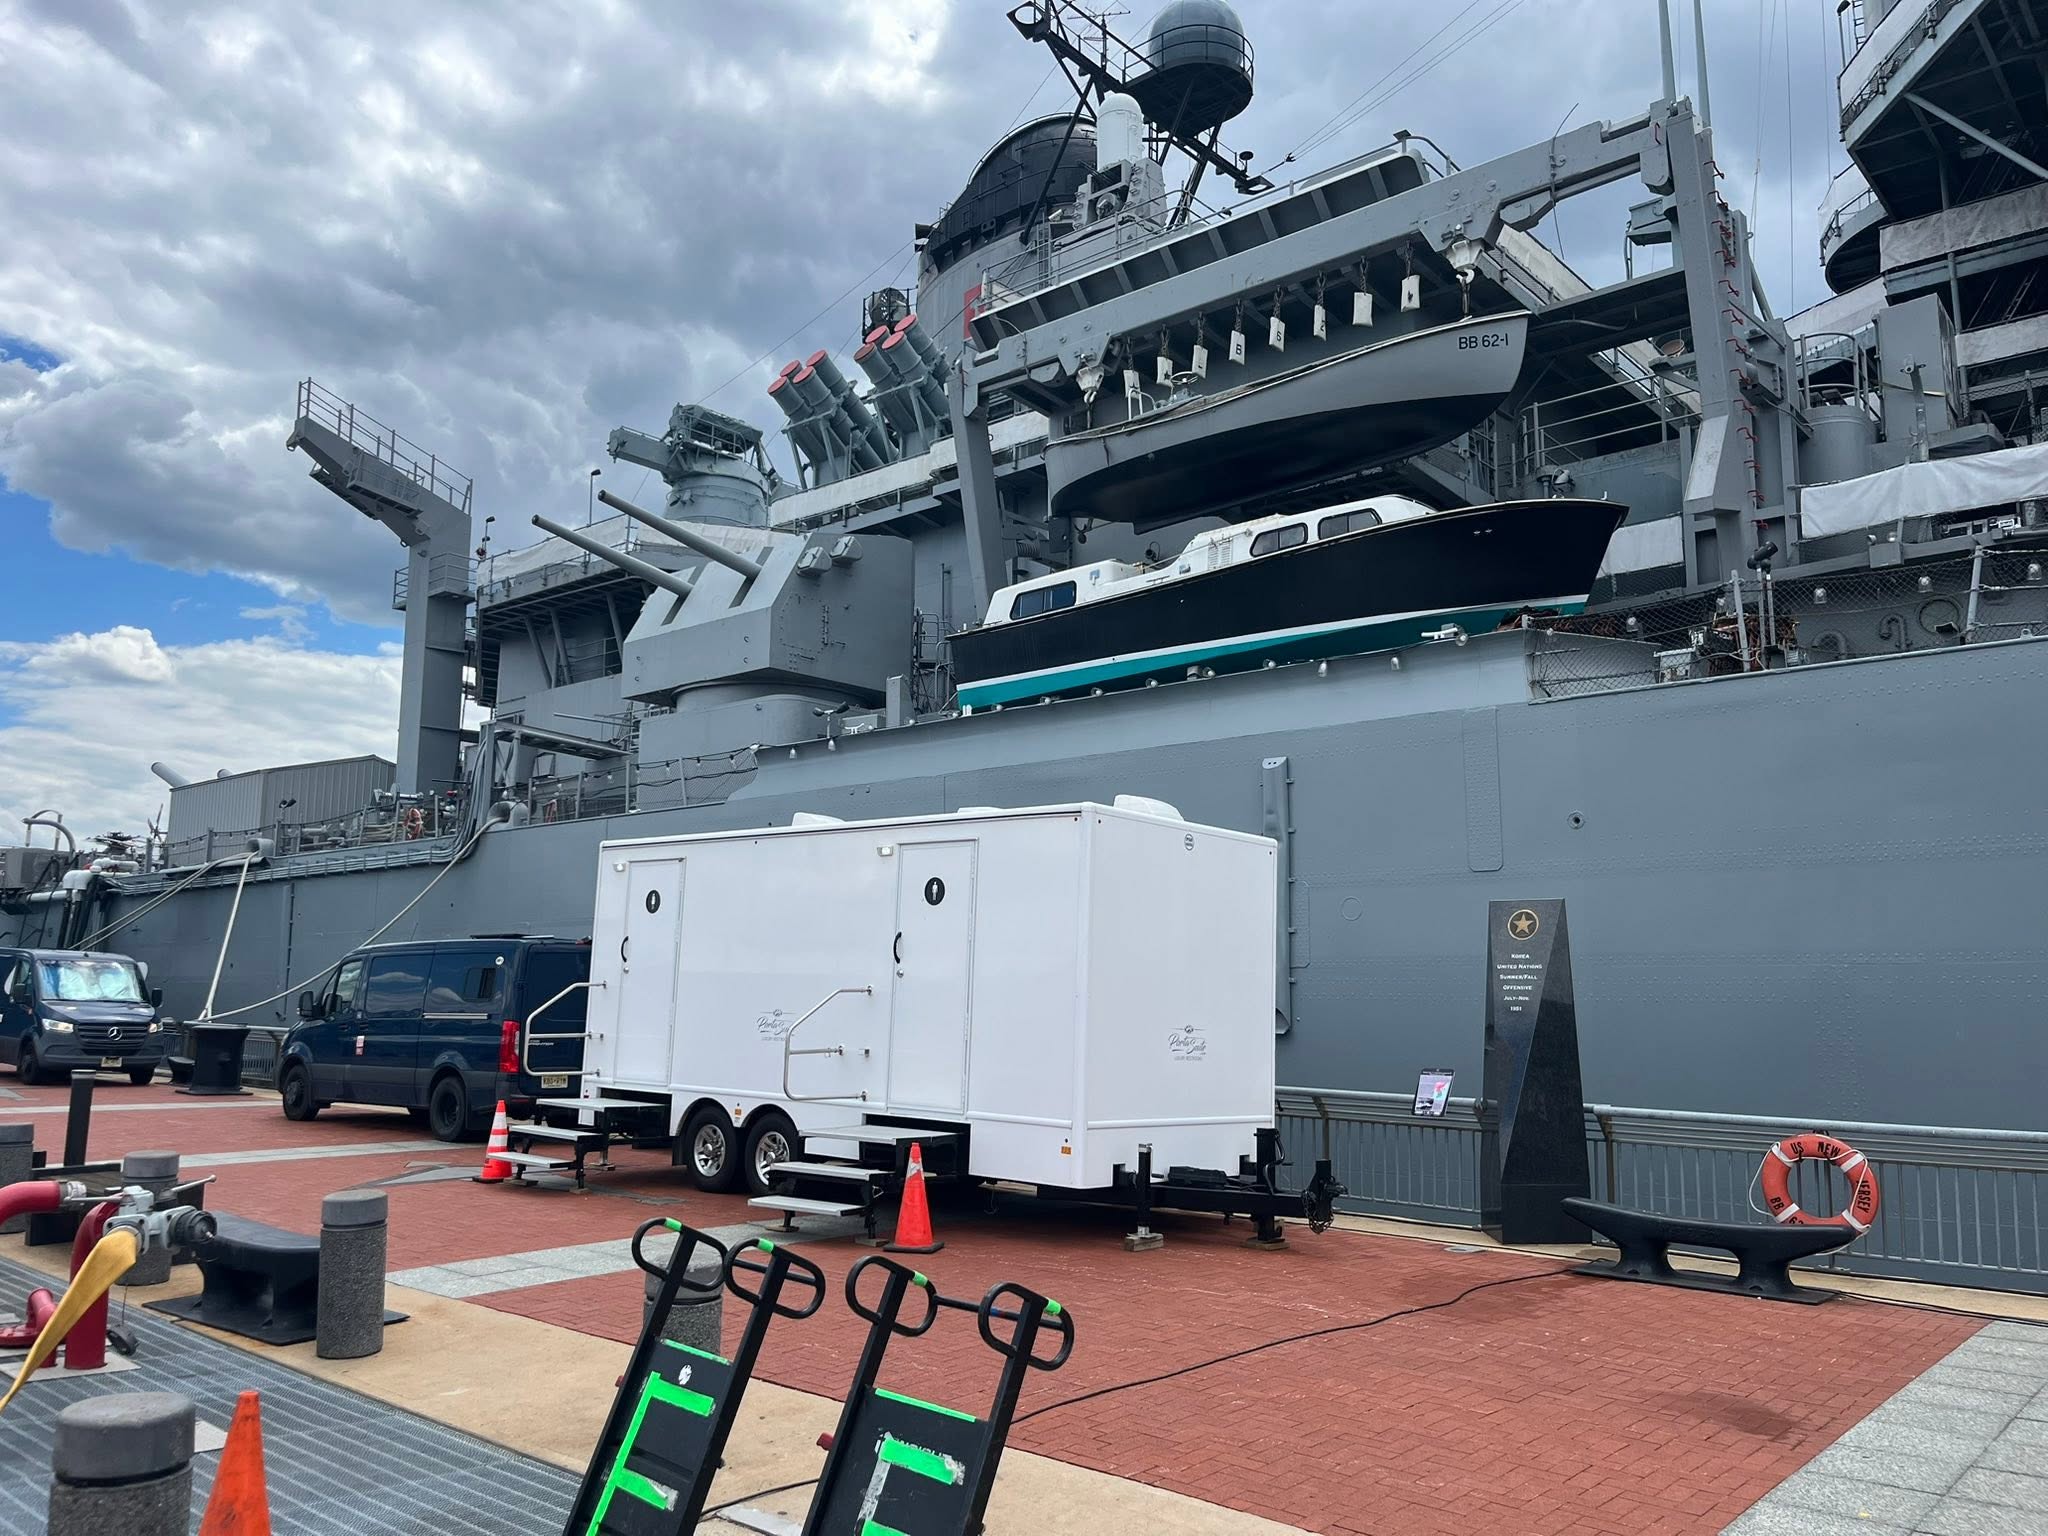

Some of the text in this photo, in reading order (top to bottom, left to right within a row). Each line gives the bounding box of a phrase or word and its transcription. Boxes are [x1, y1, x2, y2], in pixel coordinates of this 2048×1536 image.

[1458, 336, 1478, 350] BB
[1790, 1141, 1871, 1214] US NEW JERSEY
[1769, 1196, 1785, 1211] BB
